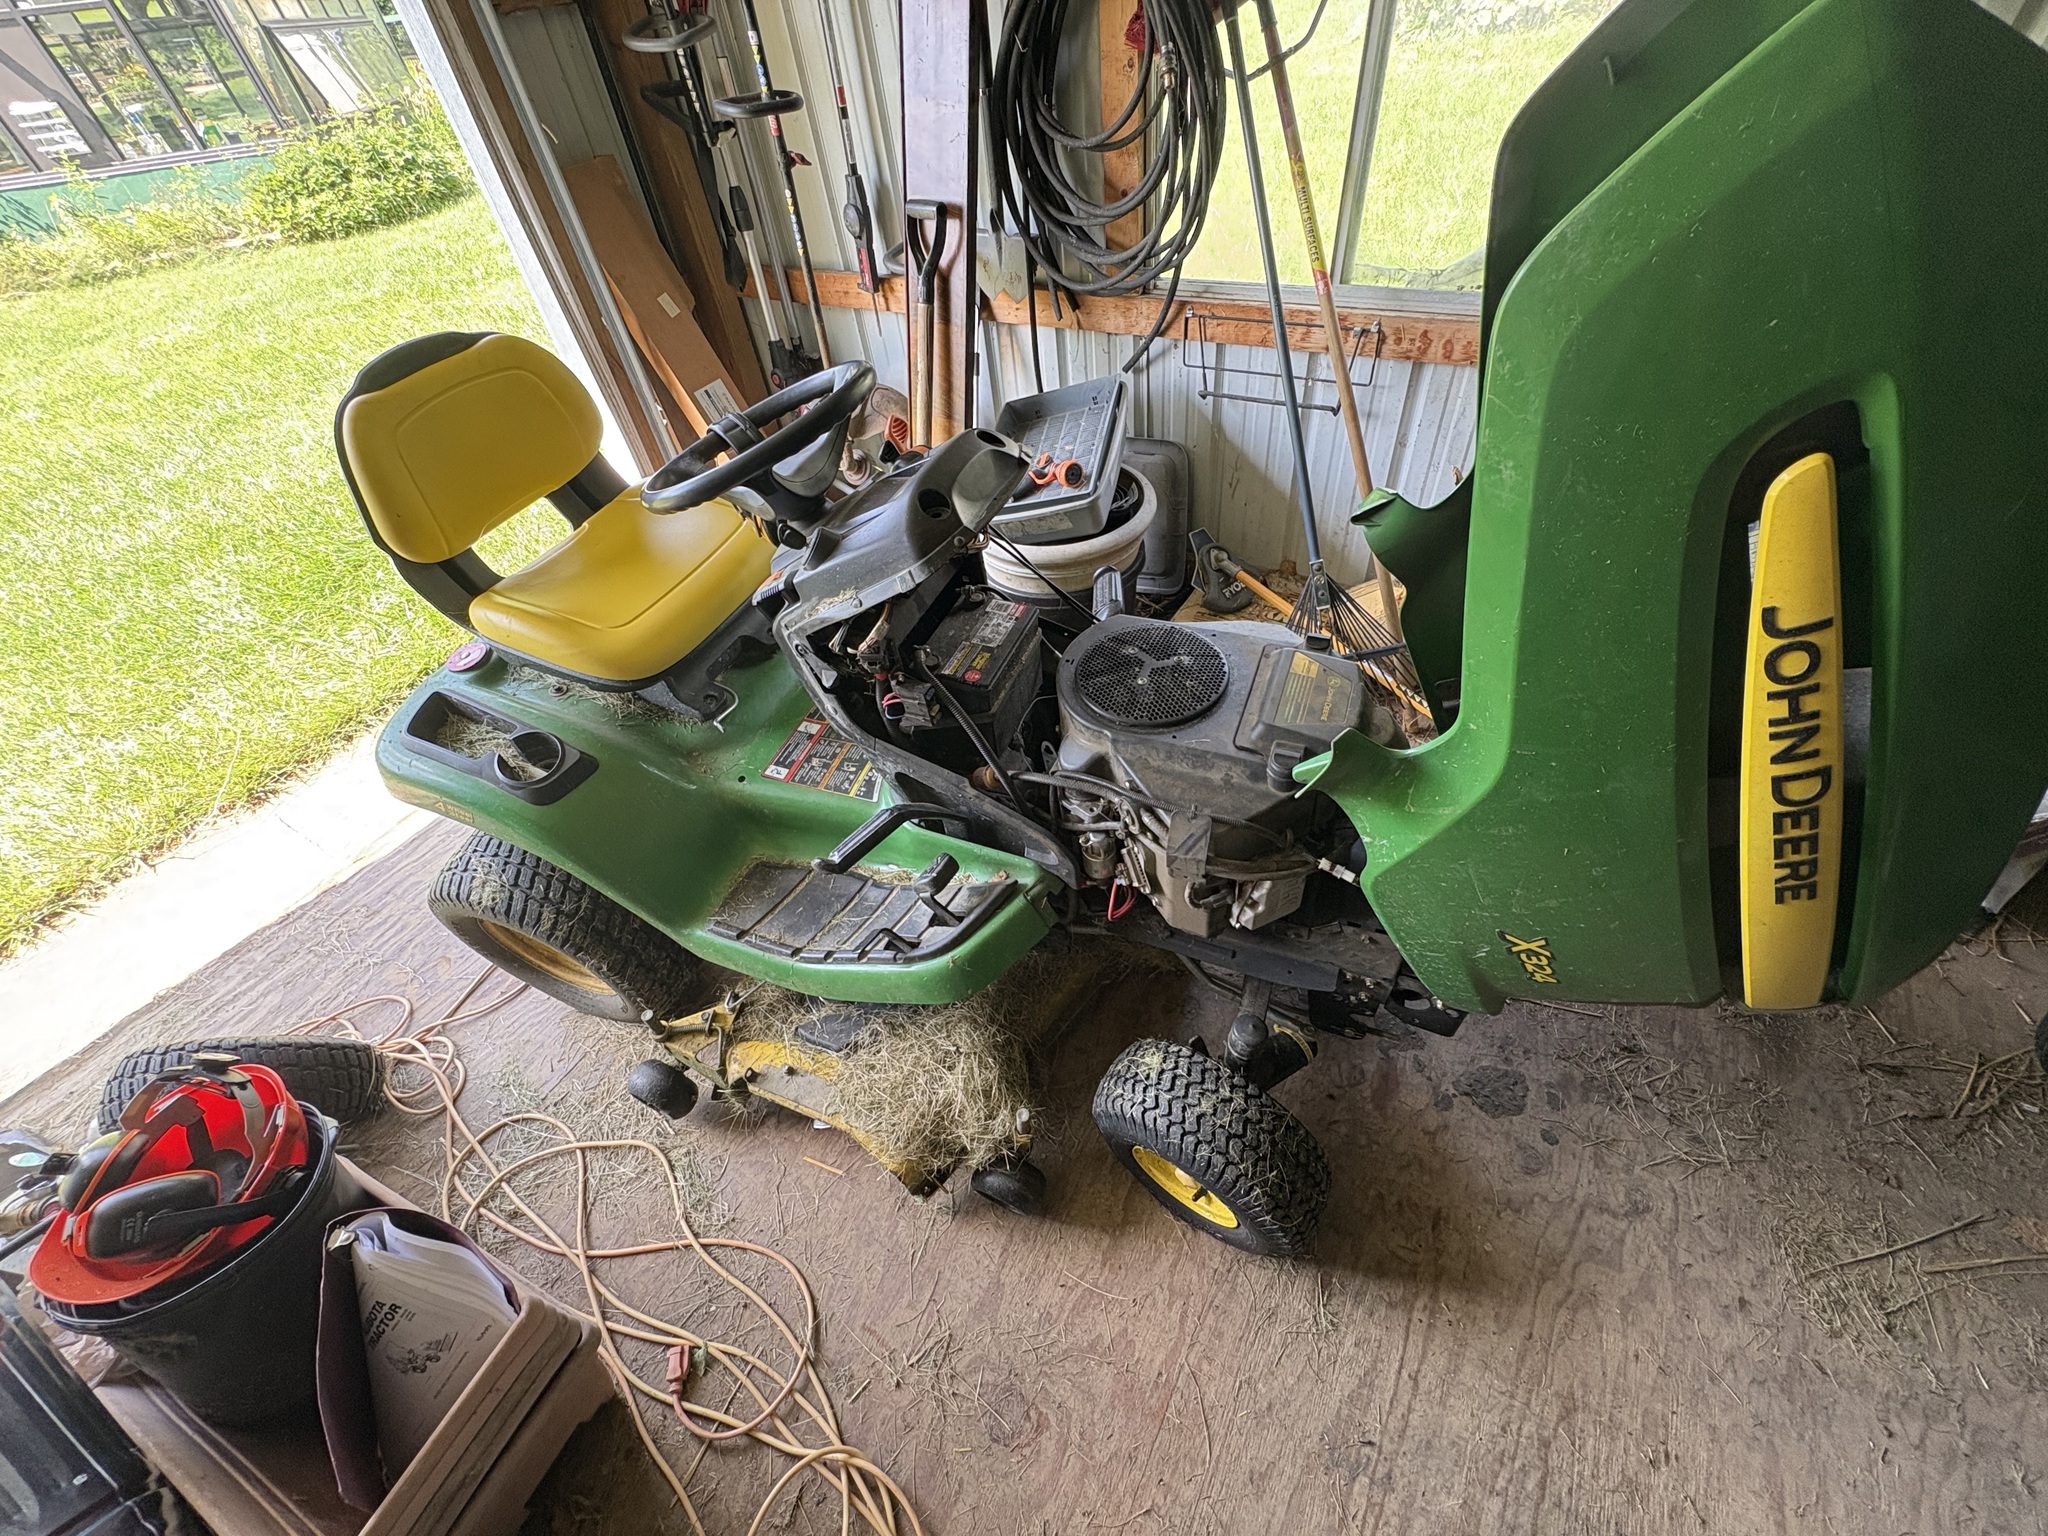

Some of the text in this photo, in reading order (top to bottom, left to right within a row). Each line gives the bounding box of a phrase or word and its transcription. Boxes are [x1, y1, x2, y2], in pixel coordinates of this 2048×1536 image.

[1297, 186, 1310, 214] MULTI
[1303, 217, 1320, 263] SURFACES
[1222, 580, 1246, 599] RYO
[1761, 605, 1834, 906] JOHN DEERE
[1499, 930, 1559, 984] X324
[364, 1300, 387, 1336] UBOTA
[368, 1303, 403, 1350] TRACTOR
